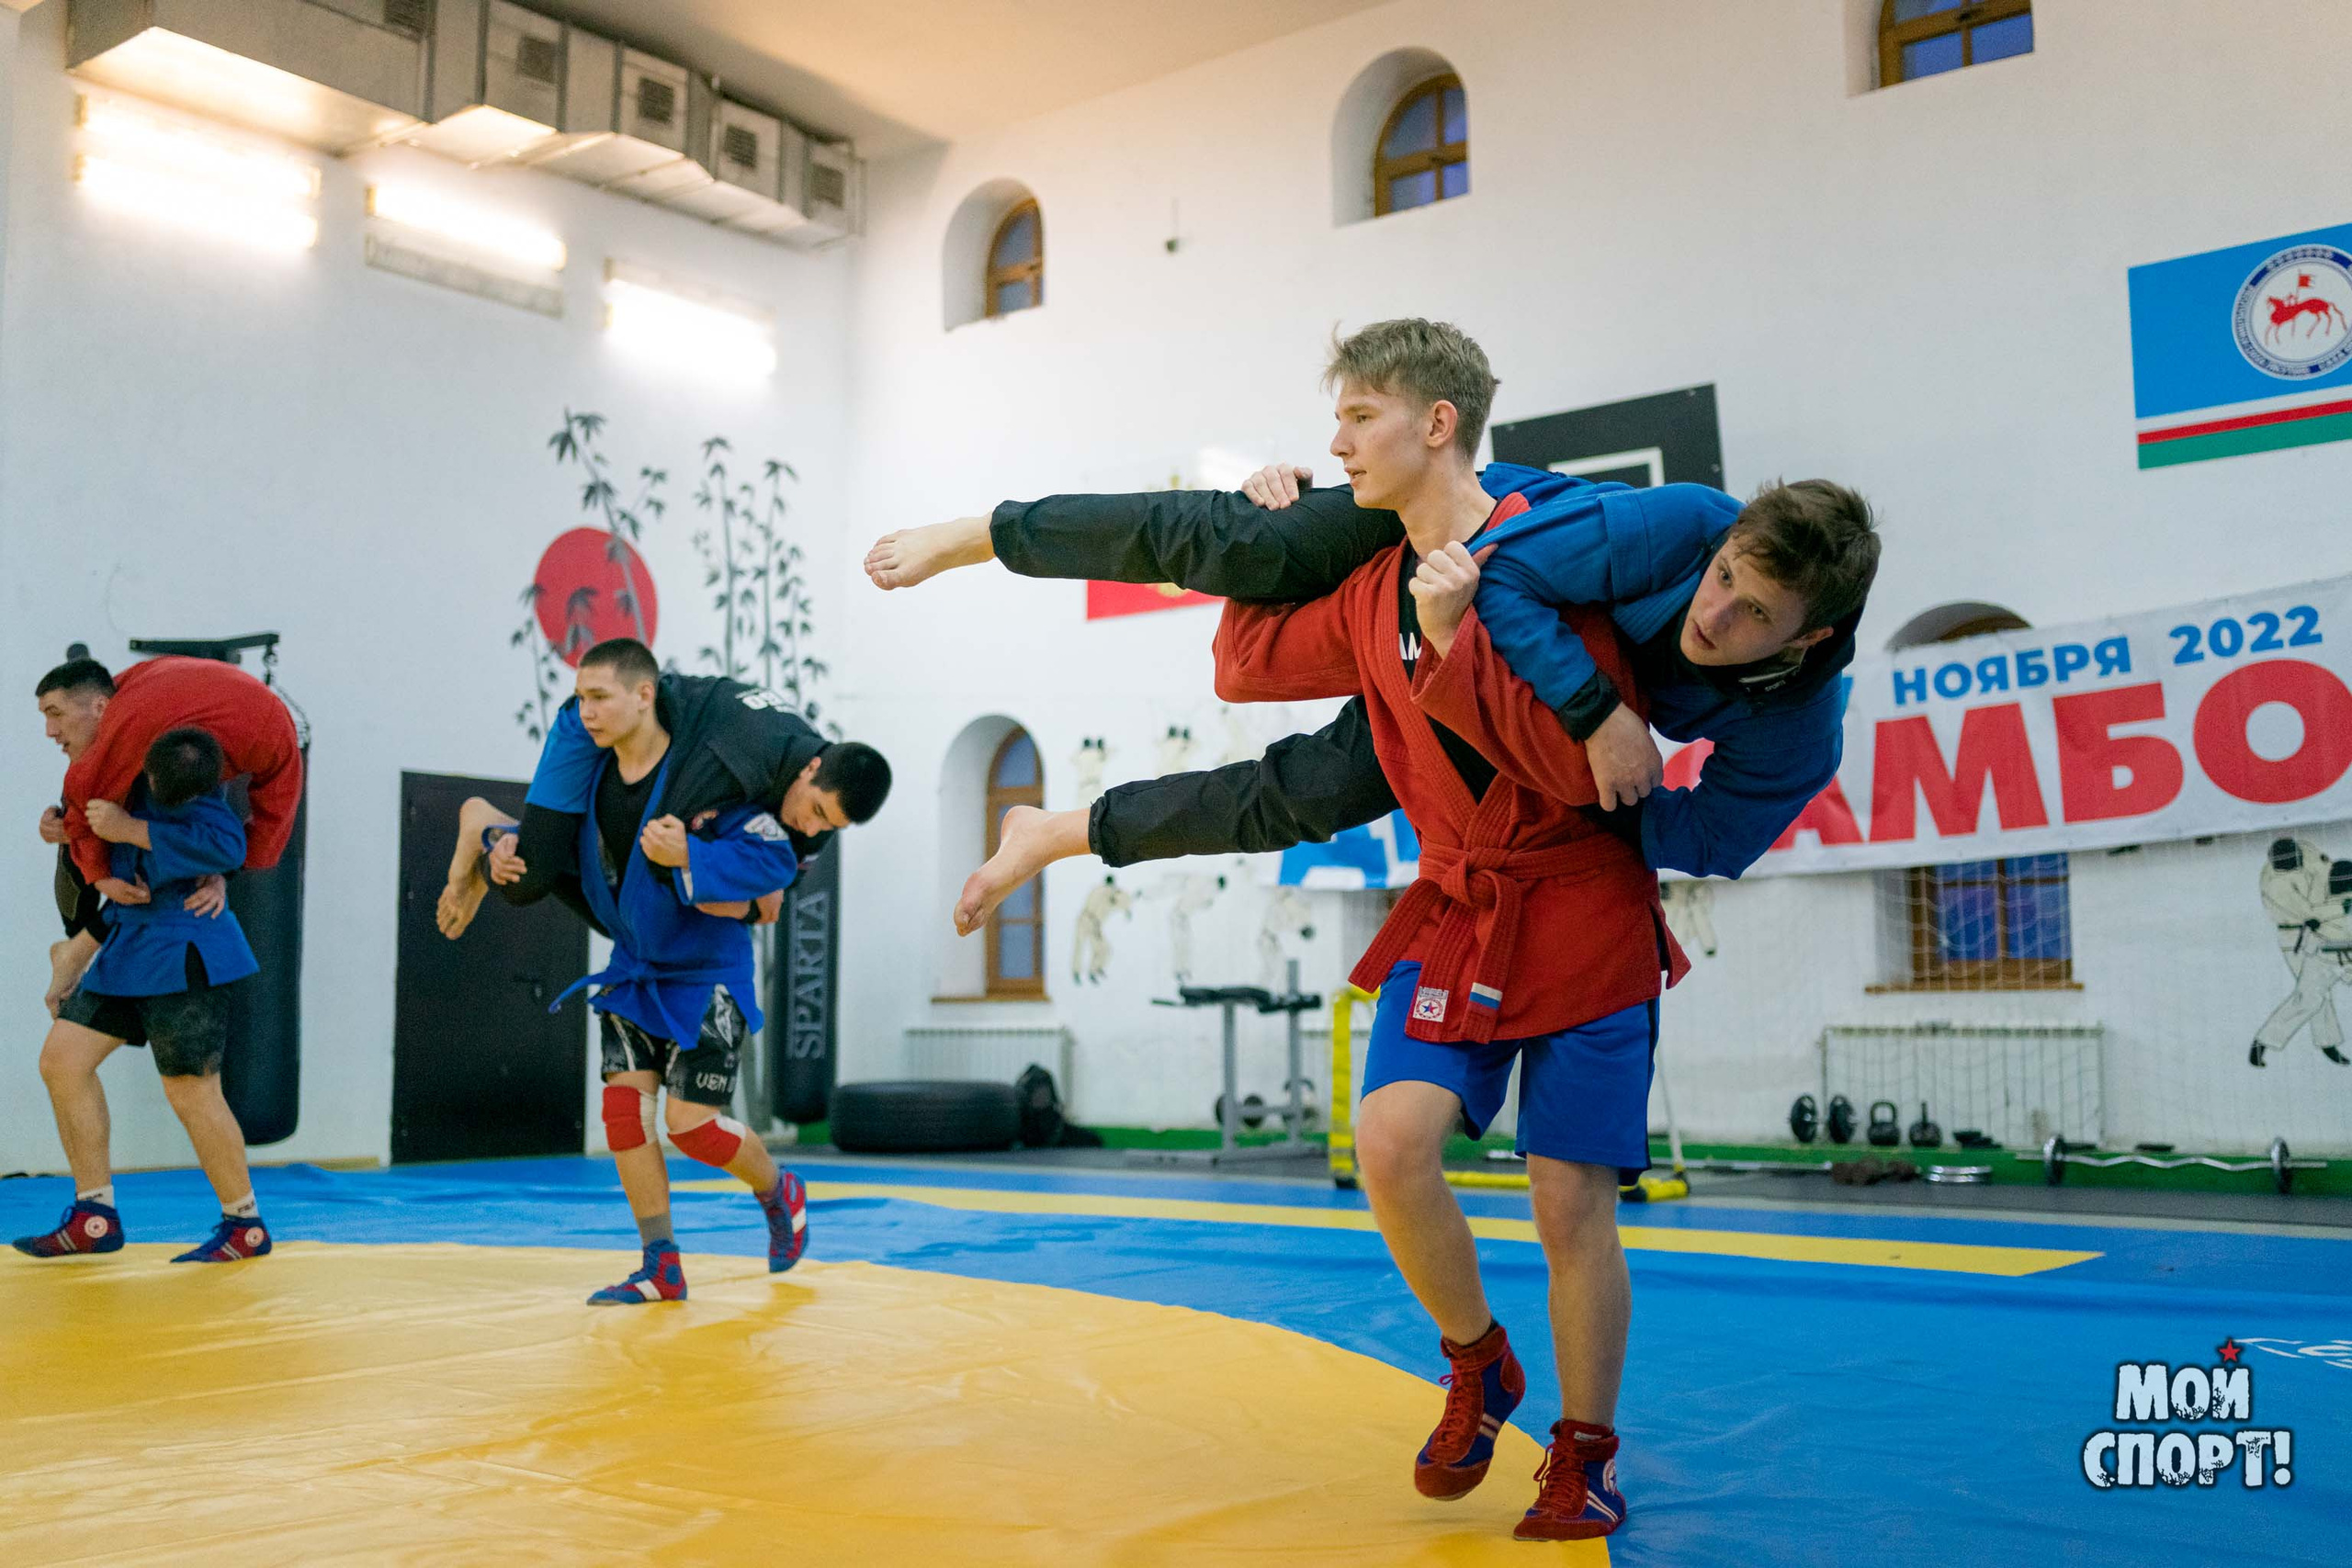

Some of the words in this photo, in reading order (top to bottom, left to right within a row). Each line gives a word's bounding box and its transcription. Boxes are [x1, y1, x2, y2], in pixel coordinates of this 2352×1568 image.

[1893, 637, 2132, 705] НОЯБРЯ
[2169, 605, 2324, 665] 2022
[1663, 659, 2352, 853] АМБО
[793, 890, 828, 1058] SPARTA
